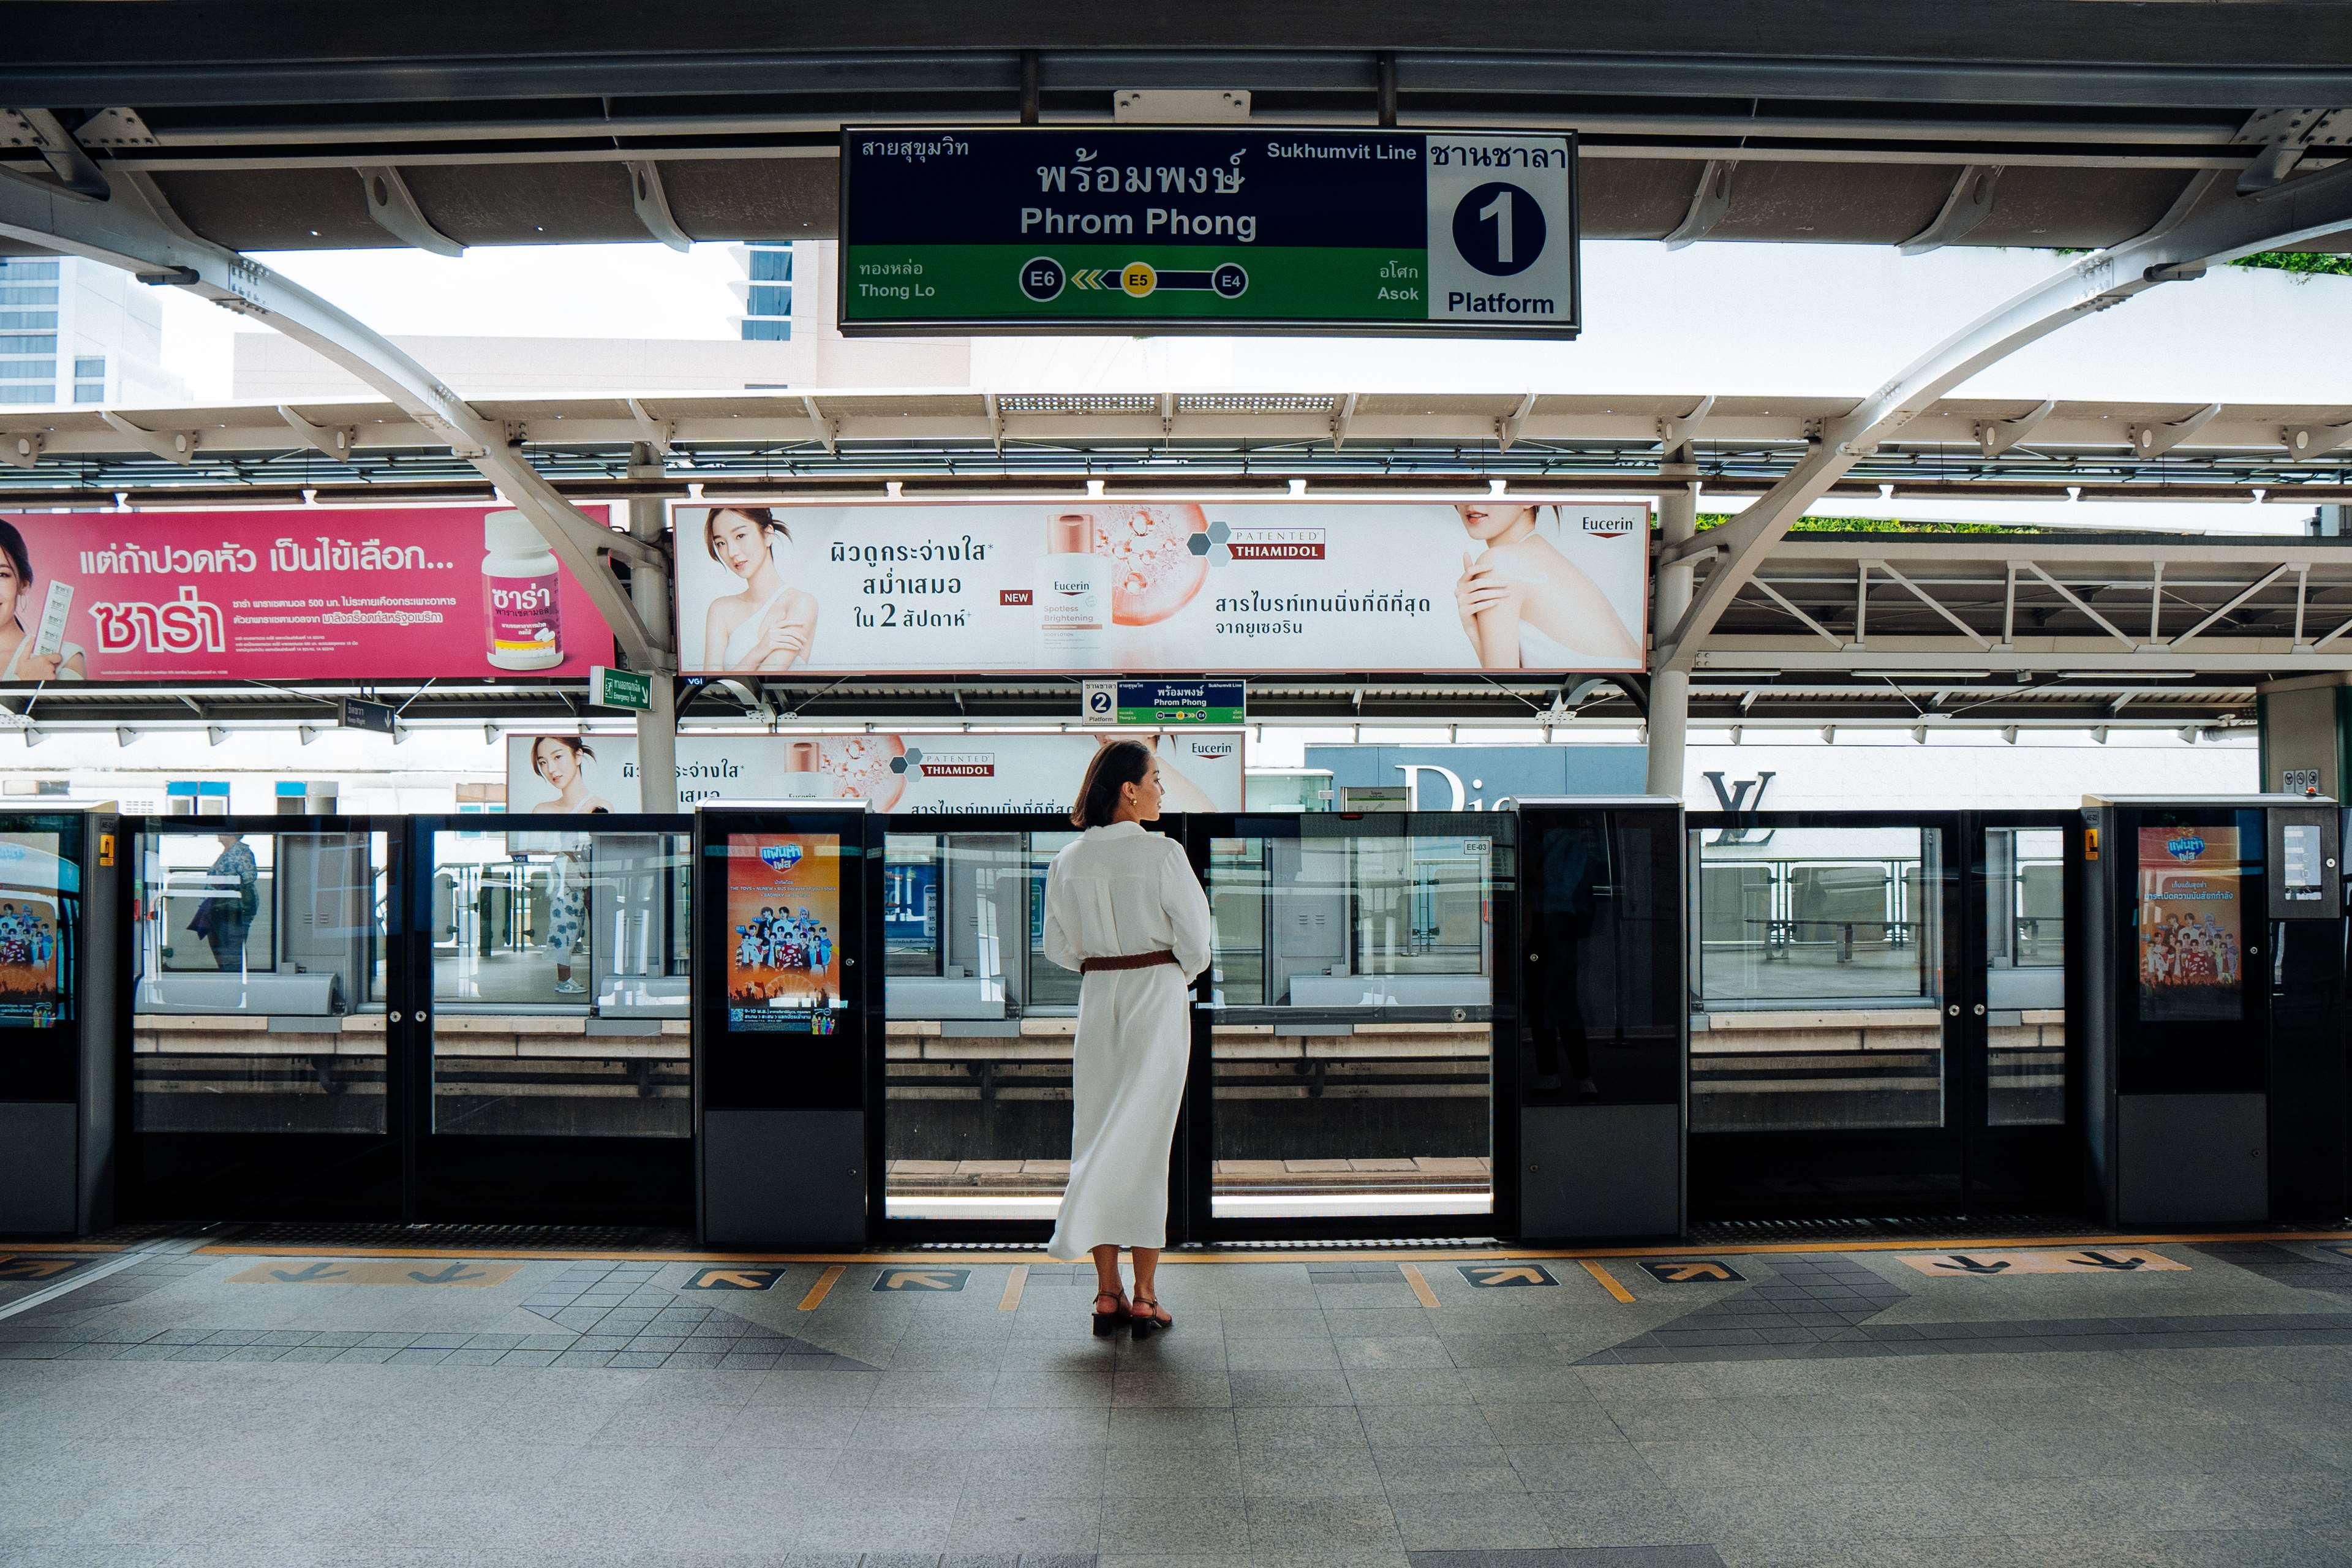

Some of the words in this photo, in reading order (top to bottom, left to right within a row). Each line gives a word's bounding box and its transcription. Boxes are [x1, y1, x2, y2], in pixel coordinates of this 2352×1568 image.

[862, 136, 969, 163] สายสุขุมวิท
[1267, 143, 1370, 159] Sukhumvit
[1377, 144, 1417, 160] Line
[1430, 145, 1566, 168] ชานชาลา
[1037, 148, 1246, 194] พร้อมพงษ์
[1021, 208, 1133, 234] Phrom
[1147, 209, 1256, 243] Phong
[1480, 192, 1513, 262] 1
[859, 258, 923, 275] ทองหล่อ
[1380, 261, 1419, 279] อโศก
[1031, 271, 1055, 286] E6
[1129, 274, 1148, 286] E5
[1222, 276, 1241, 287] E4
[859, 284, 910, 300] Thong
[915, 285, 935, 298] Lo
[1378, 287, 1419, 301] Asok
[1449, 292, 1555, 314] Platform
[1583, 517, 1634, 530] Eucerin
[1237, 532, 1317, 540] PATENTED
[80, 541, 257, 575] แต่ถ้าปวดหัว
[1236, 546, 1318, 557] THIAMIDOL
[863, 568, 961, 594] สม่ำเสมอ
[1054, 581, 1090, 590] Eucerin
[309, 598, 324, 607] 500
[342, 597, 456, 607] ไม่ระคายเคืองกระเพาะอาหาร
[492, 583, 550, 609] ซาร่า
[1005, 594, 1028, 603] NEW
[1215, 589, 1430, 616] สารไบรท์เทนนิ่งที่ดีที่สุด
[89, 586, 226, 653] ซาร่า
[854, 606, 874, 627] ใน
[880, 603, 897, 627] 2
[1044, 614, 1093, 623] Brightening
[1216, 620, 1303, 635] จากยูเซอริน
[1158, 685, 1205, 696] พร้อมพงษ์
[1095, 693, 1107, 710] 2
[1192, 743, 1232, 753] Eucerin
